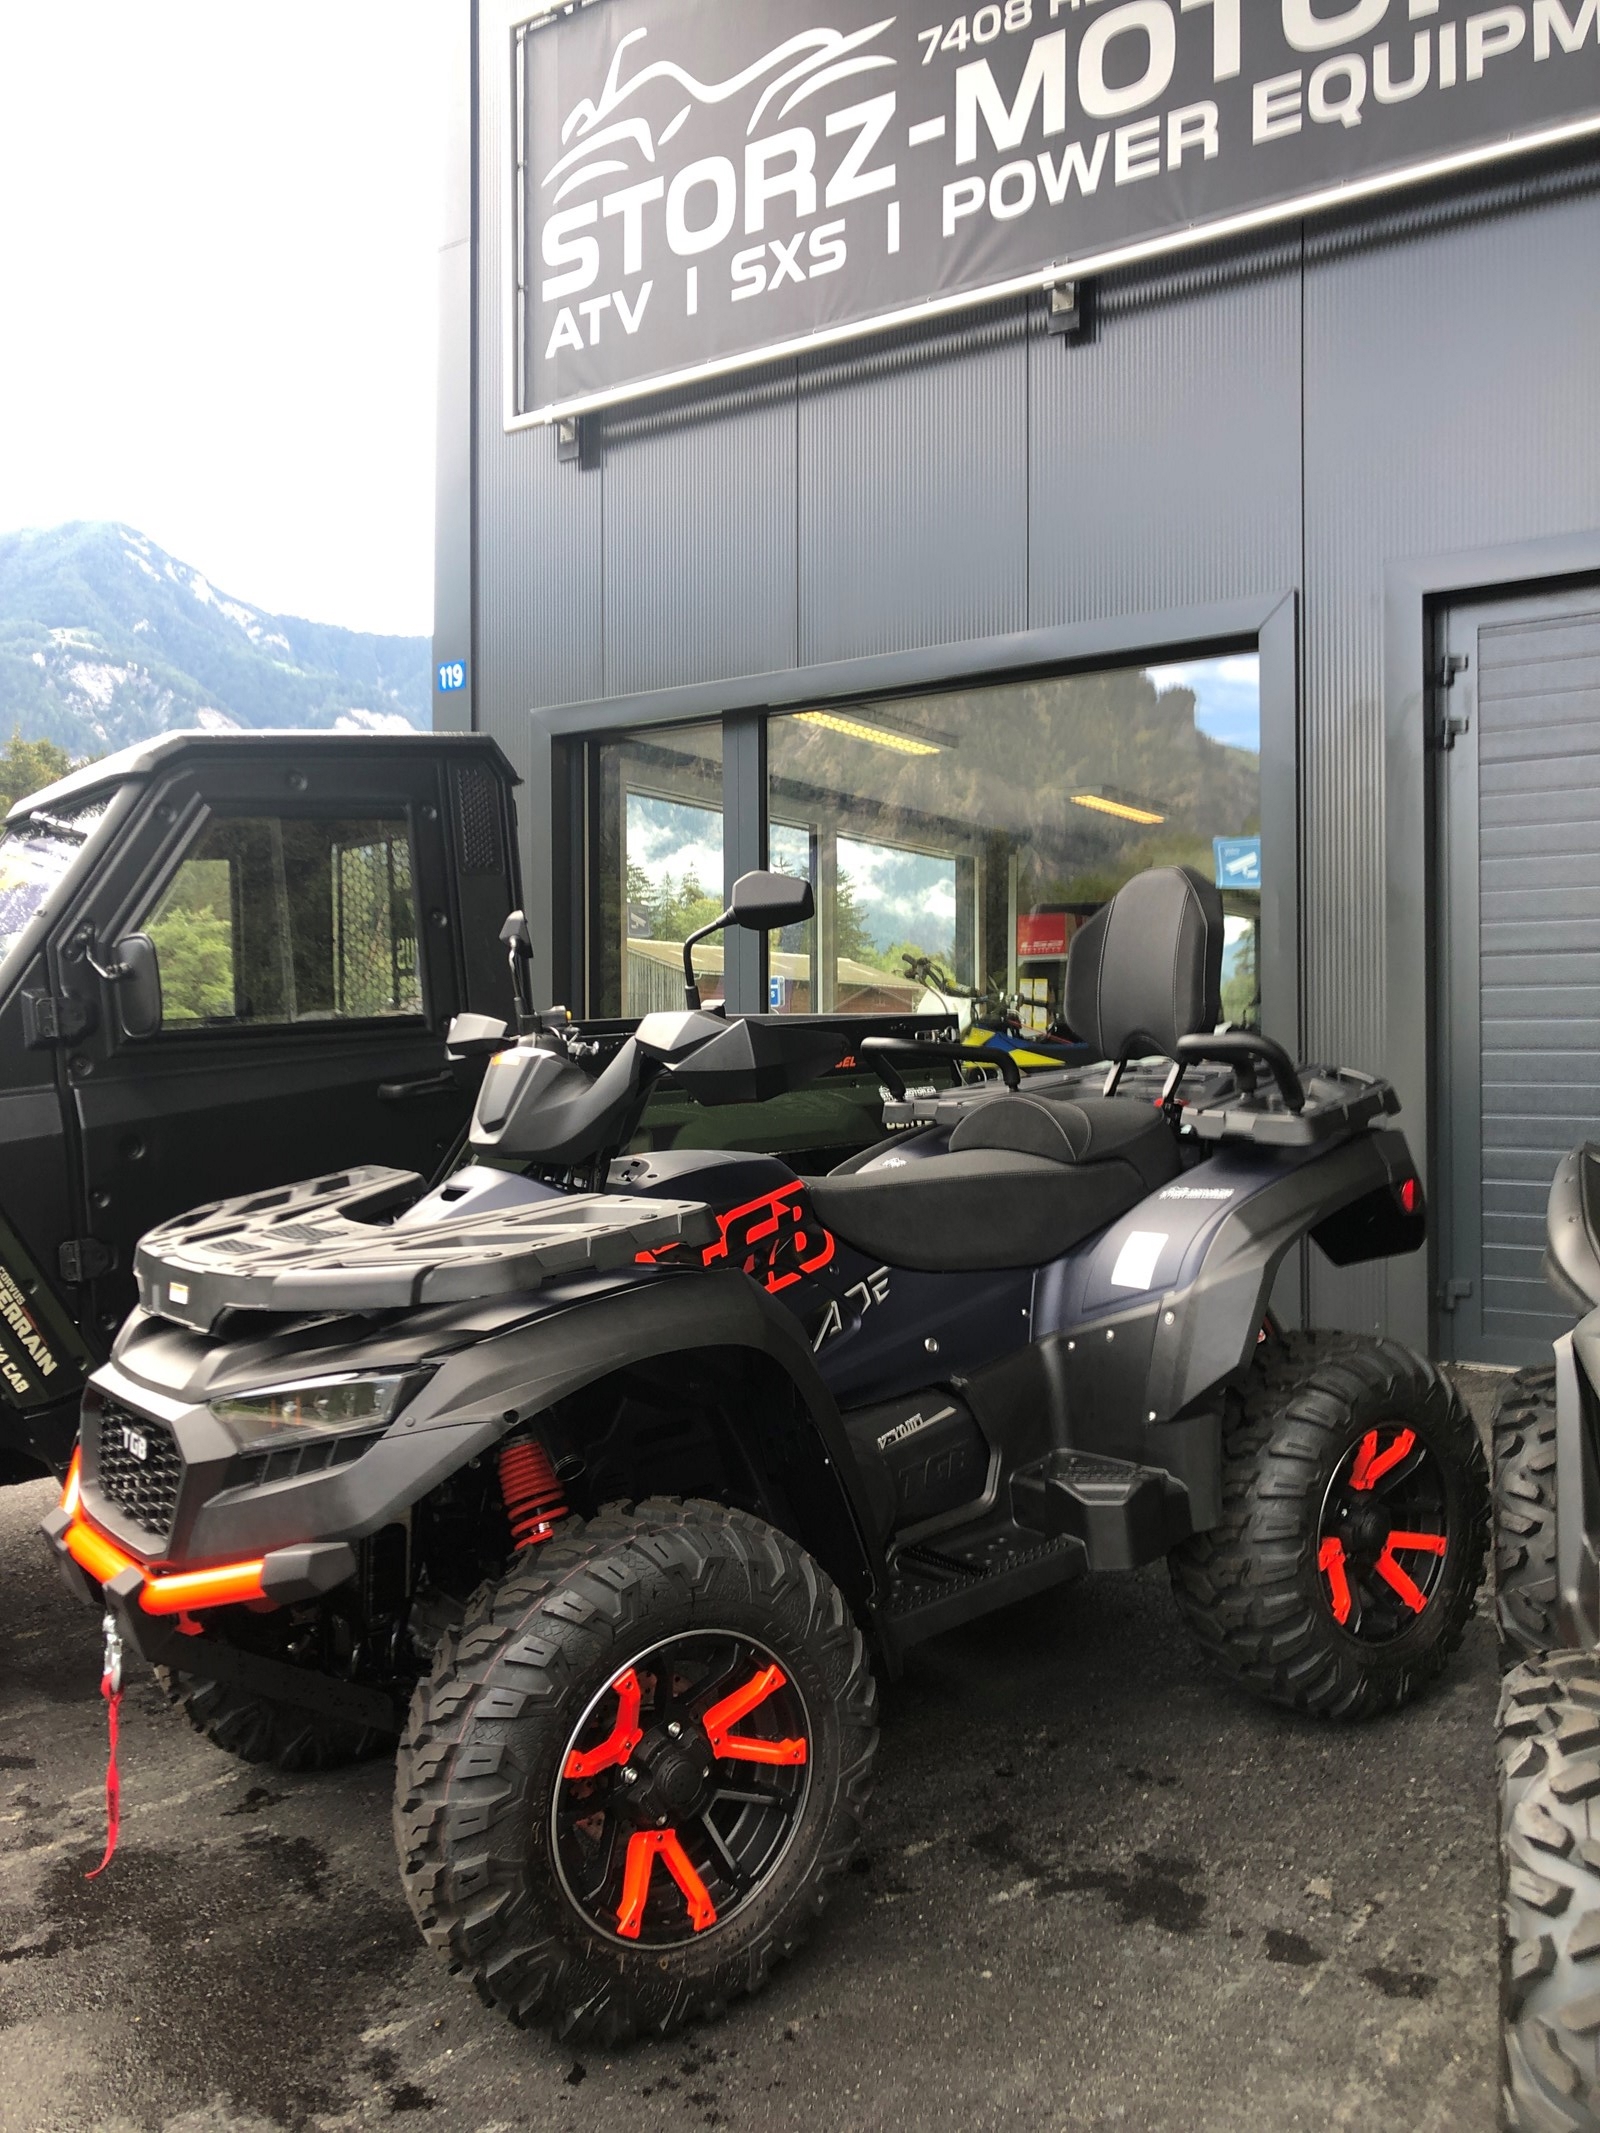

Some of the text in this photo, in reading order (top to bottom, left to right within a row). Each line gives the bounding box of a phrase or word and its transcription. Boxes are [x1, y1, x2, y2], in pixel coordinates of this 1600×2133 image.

[917, 0, 1033, 65] 7408
[541, 0, 1441, 302] STORZ-MOT
[544, 280, 653, 360] ATV
[730, 218, 847, 303] SXS
[942, 99, 1220, 238] POWER
[439, 663, 464, 689] 119
[2, 1362, 30, 1393] CAB
[121, 1425, 147, 1461] TGB
